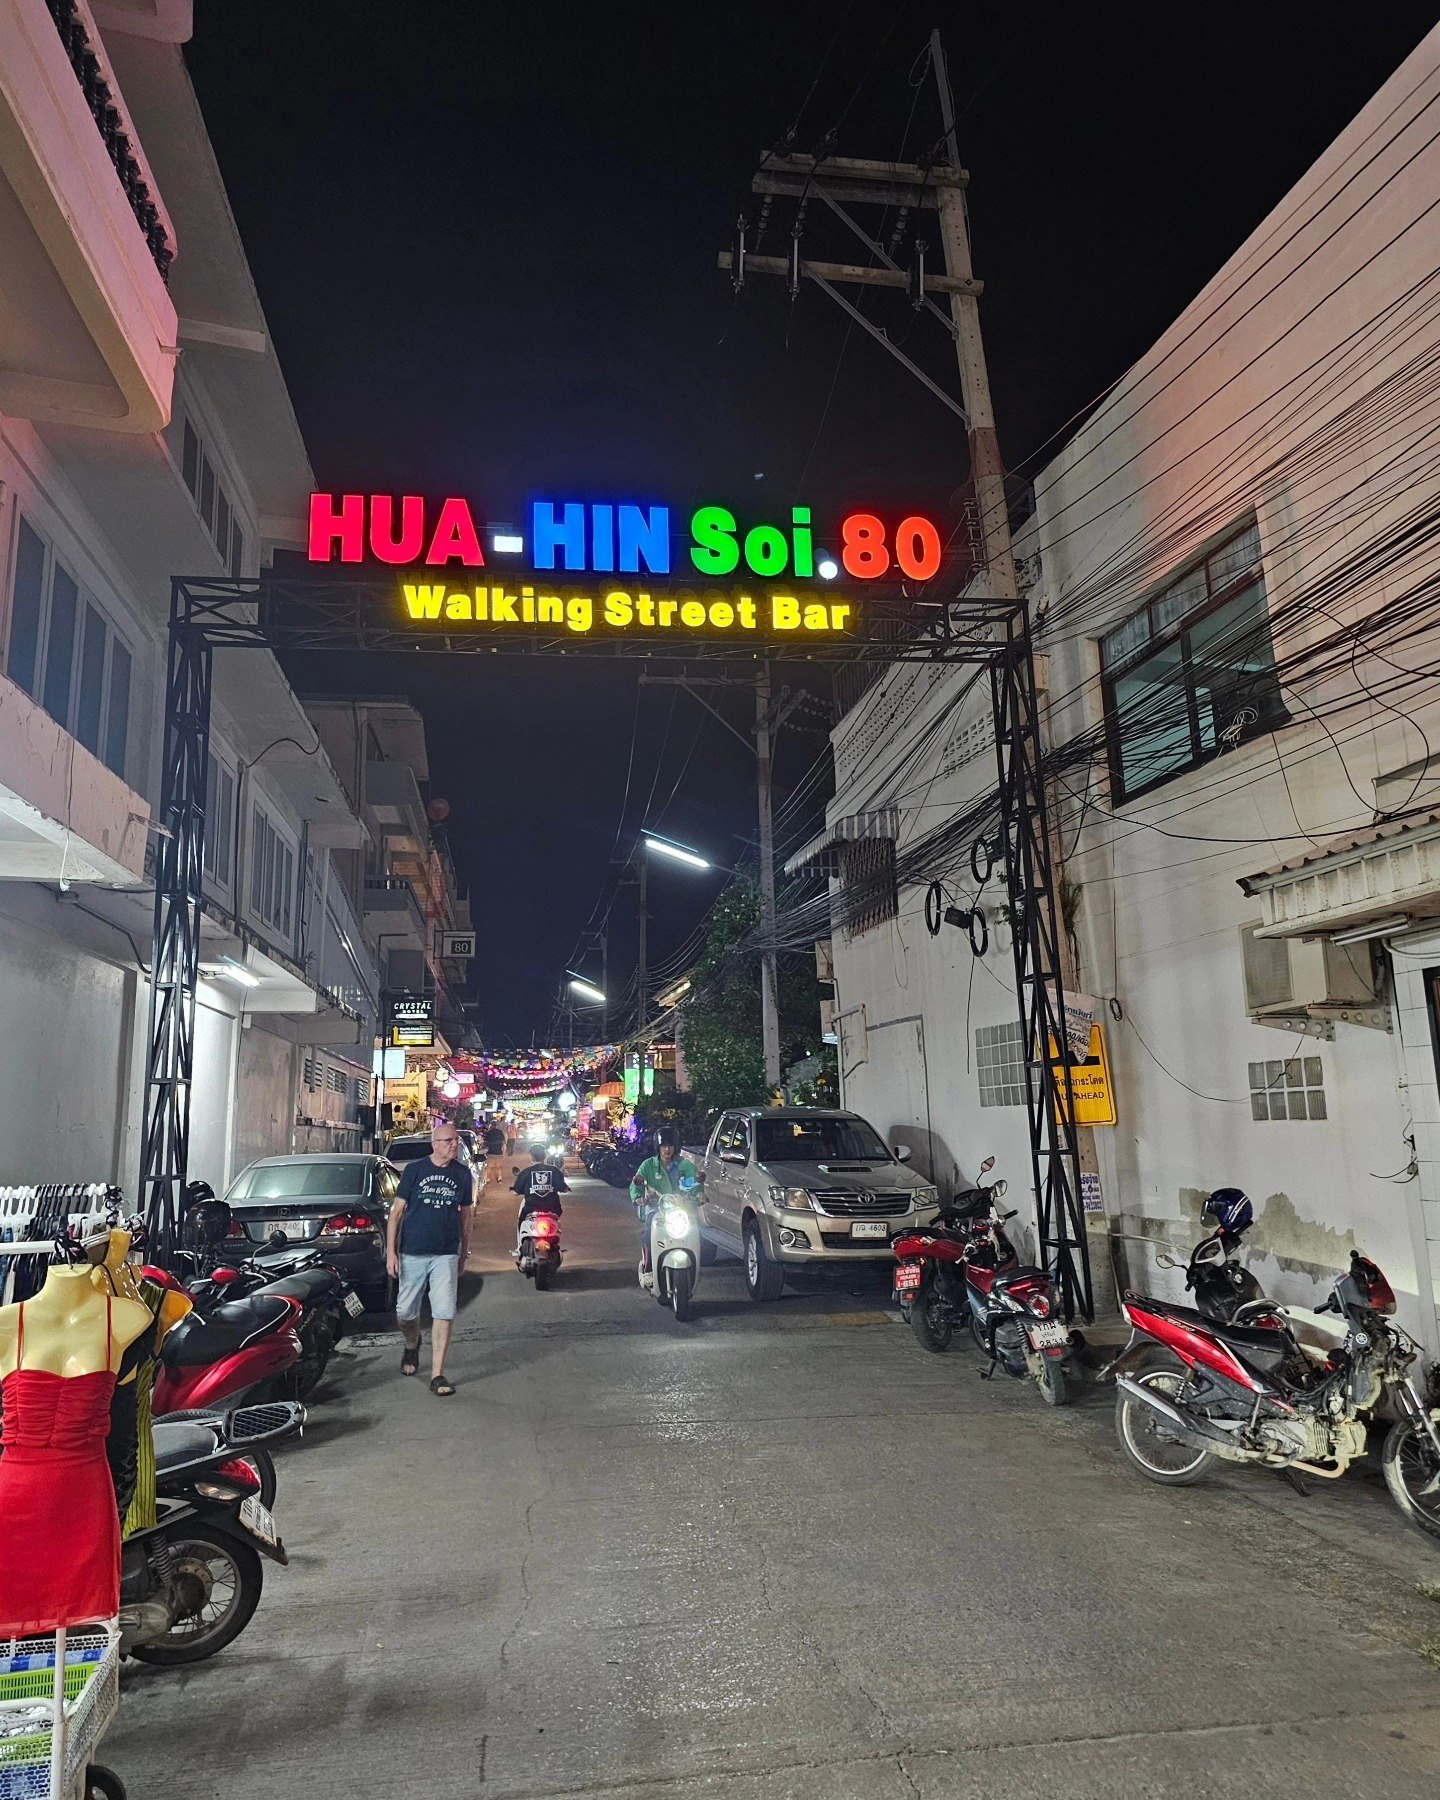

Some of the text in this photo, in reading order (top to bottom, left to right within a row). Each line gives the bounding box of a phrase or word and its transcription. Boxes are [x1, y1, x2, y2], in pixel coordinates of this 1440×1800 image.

[403, 585, 852, 633] Walking Street Bar
[454, 942, 469, 953] 80
[394, 1002, 432, 1010] CRYSTAL
[1075, 1091, 1105, 1101] AHEAD
[418, 1174, 458, 1189] DETROIT CITY
